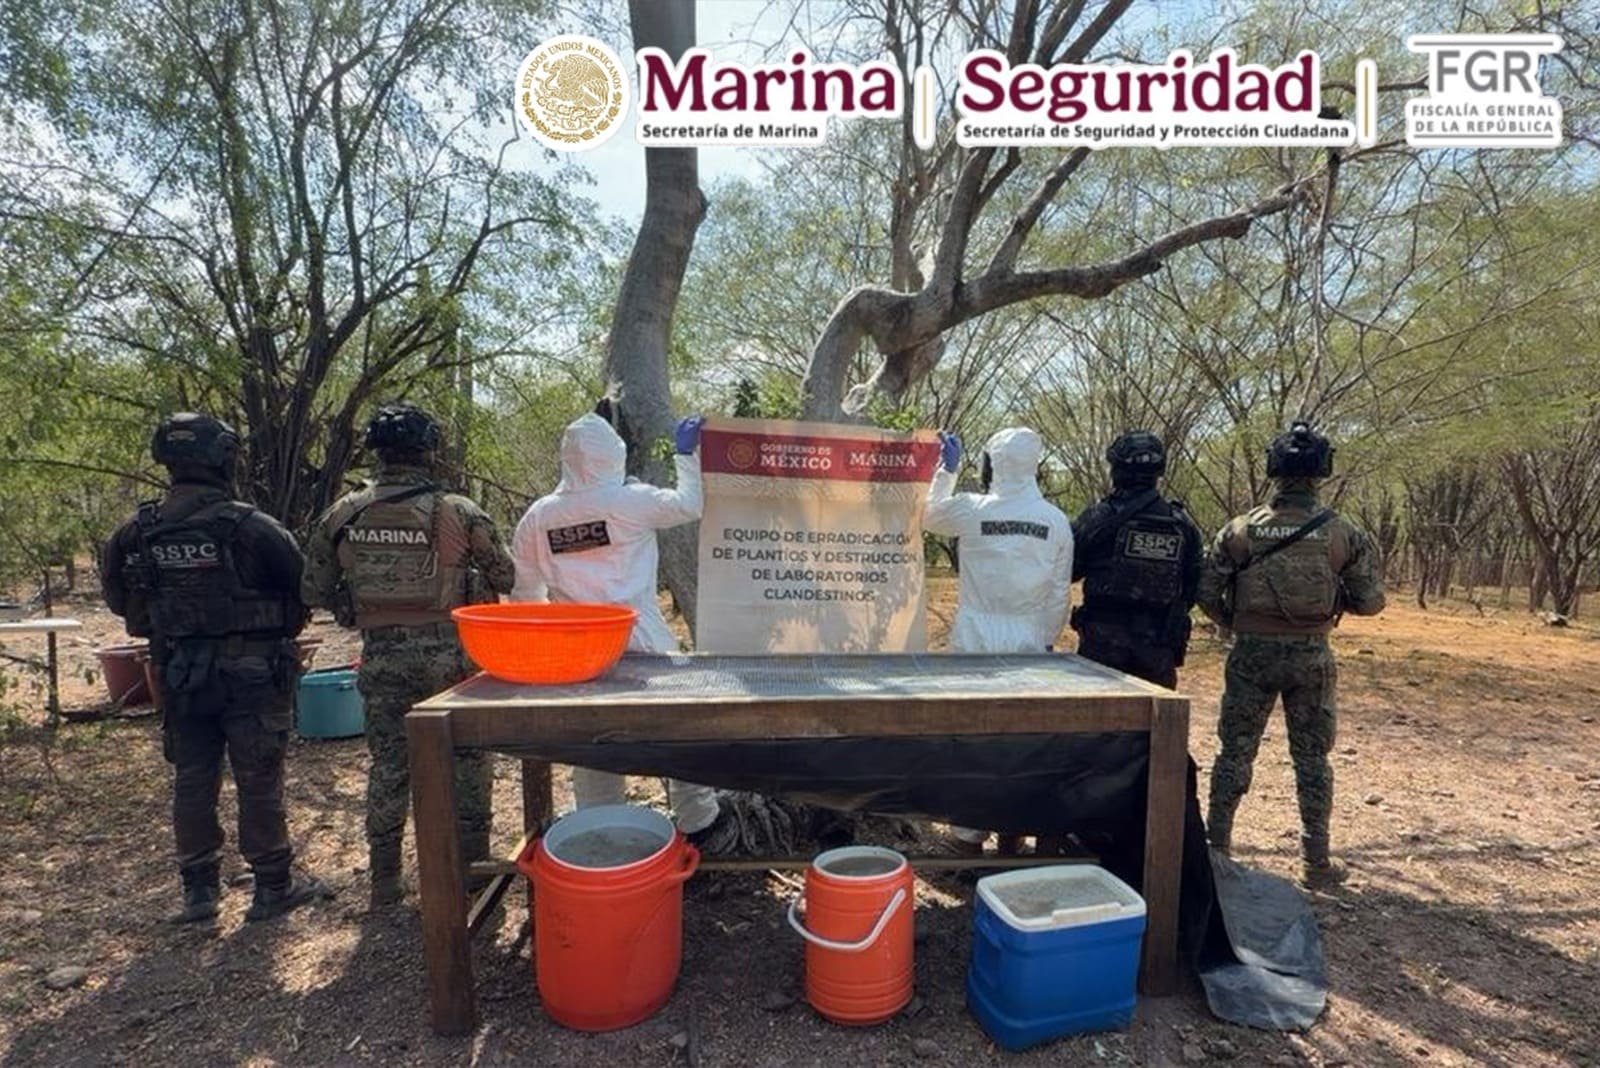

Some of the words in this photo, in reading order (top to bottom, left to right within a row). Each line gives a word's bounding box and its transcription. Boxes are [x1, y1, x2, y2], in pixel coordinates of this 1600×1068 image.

[850, 452, 917, 468] MARINA
[349, 529, 429, 545] MARINA
[550, 522, 605, 544] SSPC
[723, 528, 780, 543] EQUIPO
[783, 530, 803, 543] DE
[1134, 534, 1177, 549] SSPC
[151, 543, 217, 561] SSPC
[712, 547, 733, 560] DE
[812, 550, 821, 562] Y
[752, 568, 770, 581] DE
[776, 568, 888, 583] LABORATORIOS
[764, 587, 876, 601] CLANDESTINOS
